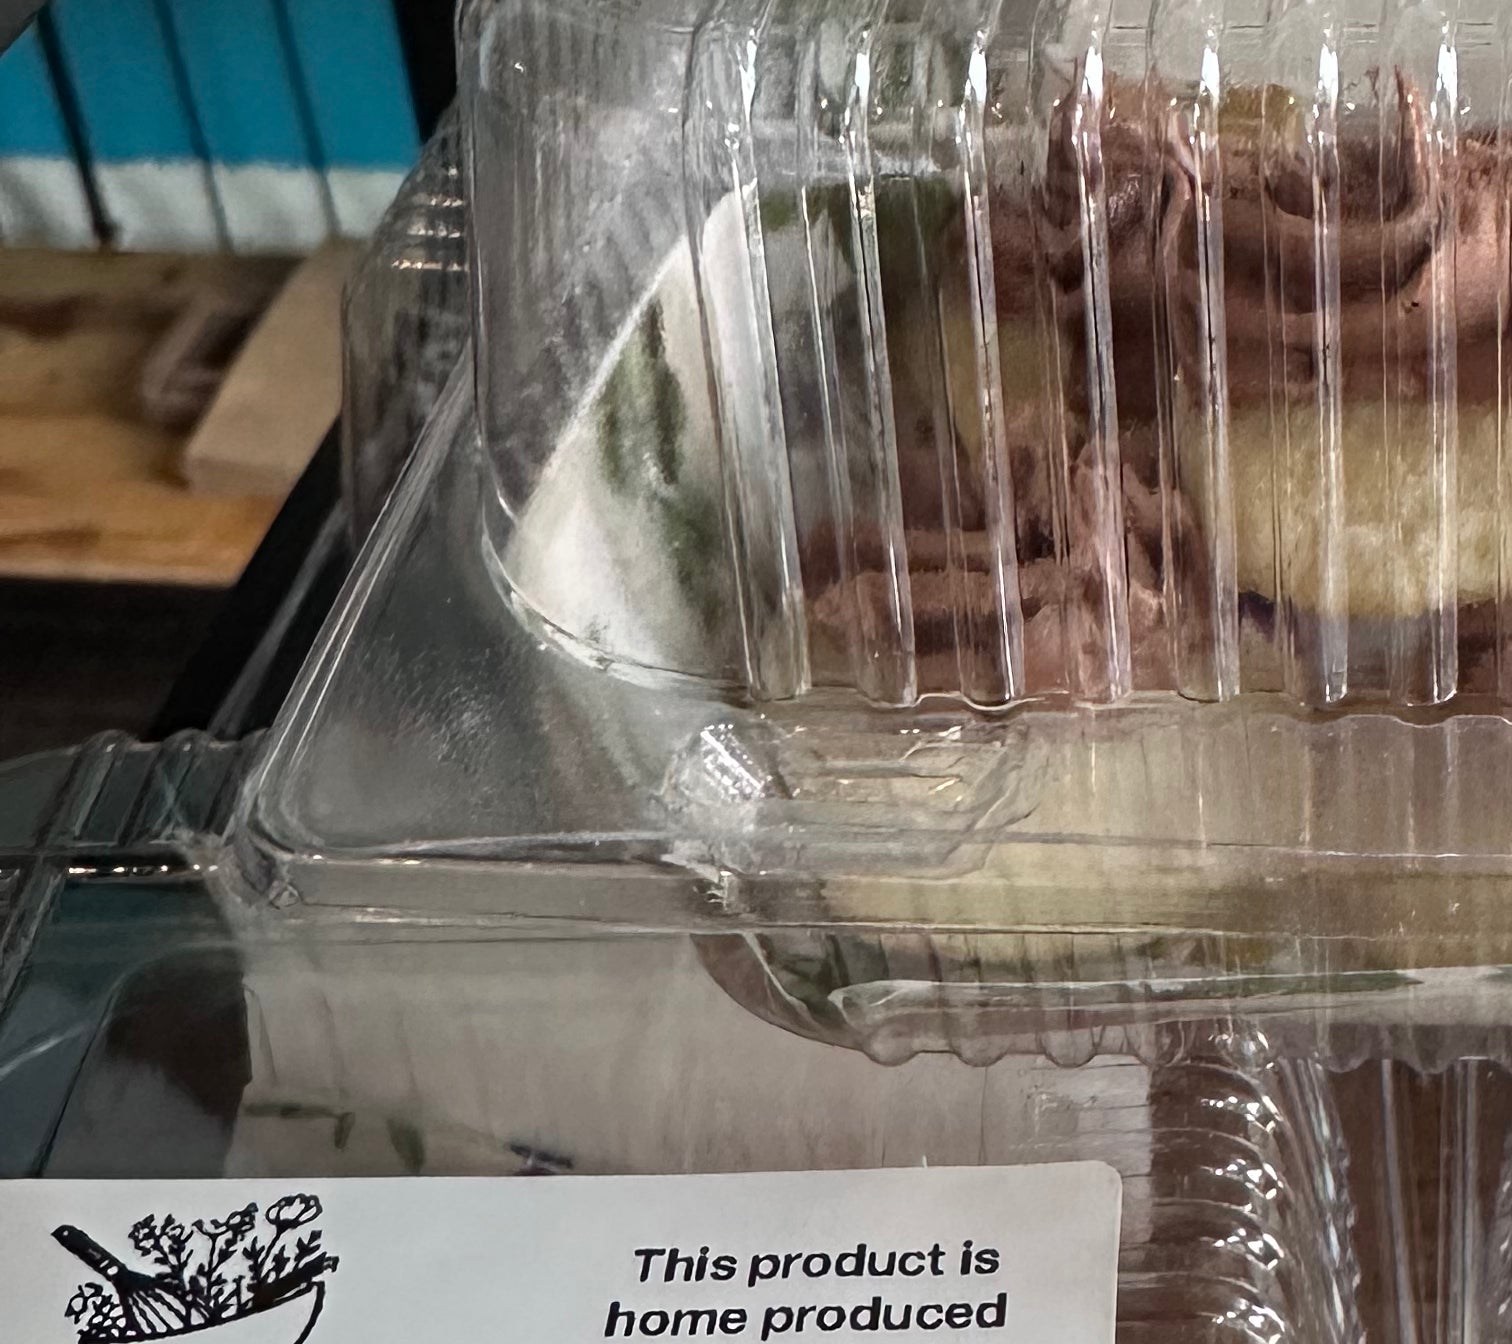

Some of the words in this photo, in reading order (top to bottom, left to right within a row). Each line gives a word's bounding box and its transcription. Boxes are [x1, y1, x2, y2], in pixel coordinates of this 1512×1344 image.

[634, 1245, 738, 1283] This
[747, 1243, 946, 1288] product
[960, 1239, 1000, 1276] is
[604, 1301, 748, 1338] home
[760, 1292, 1008, 1342] produced
